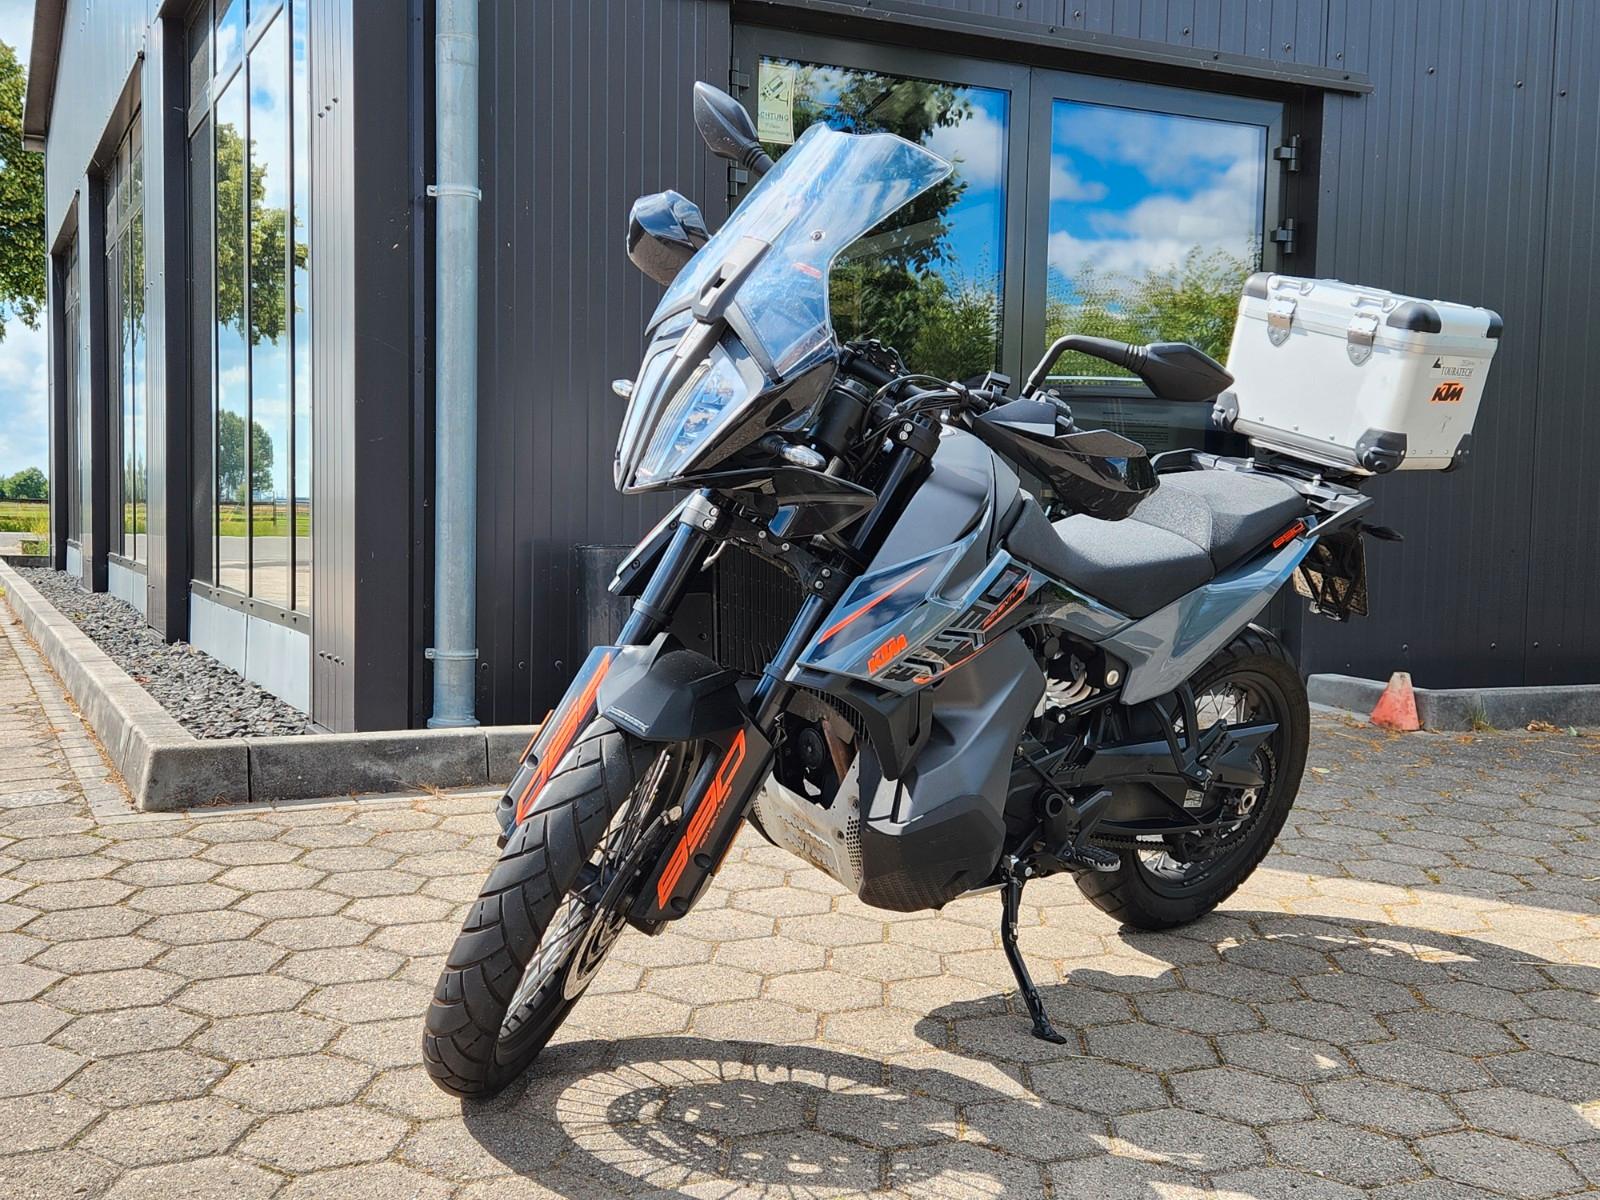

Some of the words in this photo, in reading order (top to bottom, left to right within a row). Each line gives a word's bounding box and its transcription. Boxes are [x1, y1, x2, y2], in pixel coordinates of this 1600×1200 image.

[1441, 366, 1473, 377] TOURATECH
[1431, 382, 1464, 401] KTM
[1272, 521, 1305, 548] 890
[867, 633, 908, 676] KTM
[657, 729, 746, 910] 890
